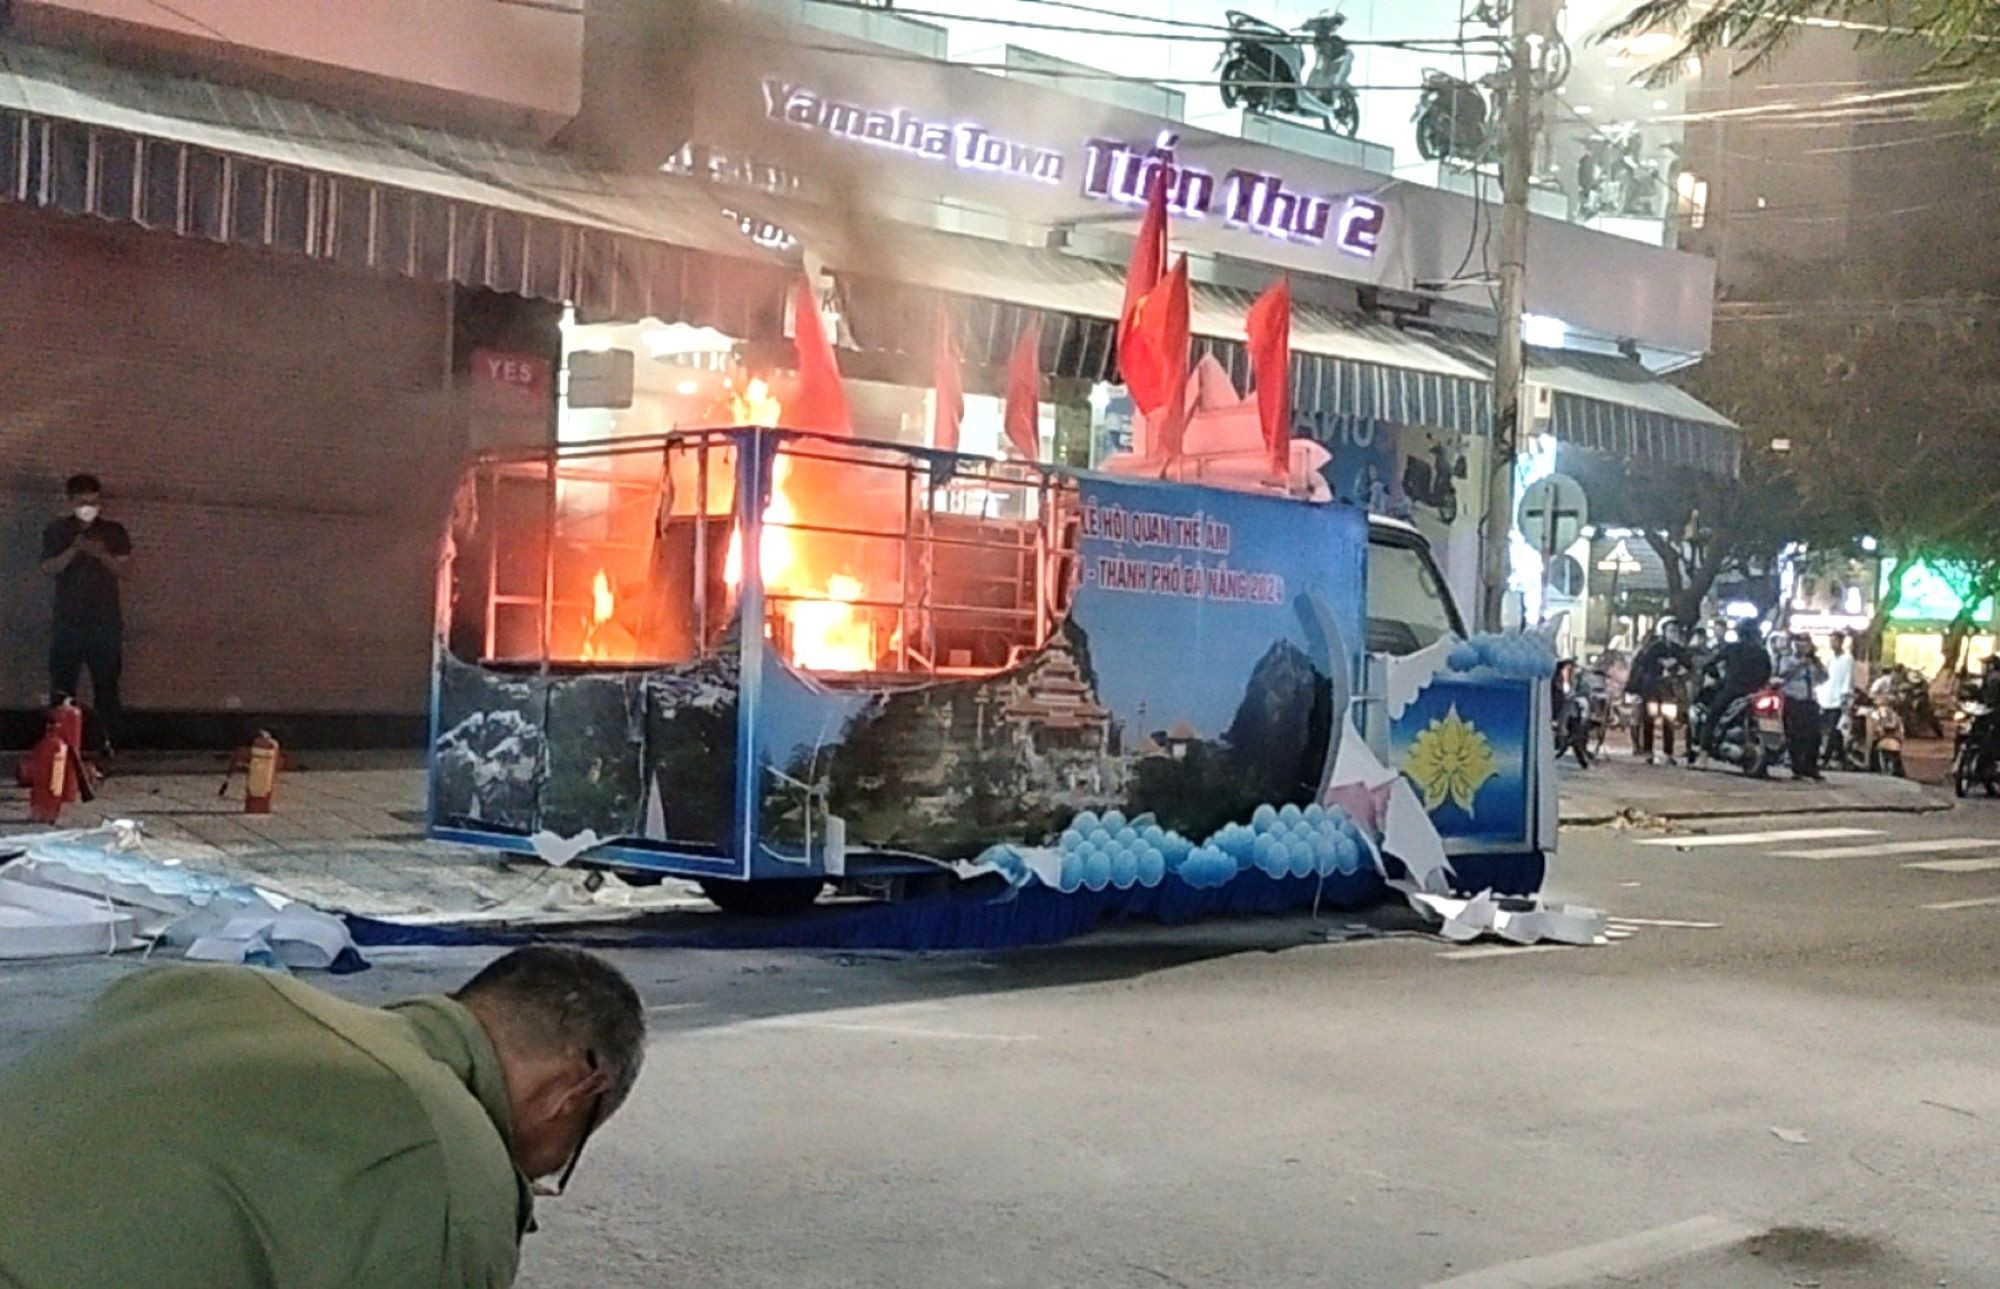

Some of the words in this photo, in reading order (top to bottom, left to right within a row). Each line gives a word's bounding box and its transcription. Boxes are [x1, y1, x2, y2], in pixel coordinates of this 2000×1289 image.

[761, 78, 951, 158] Yamaha
[955, 123, 1064, 184] Town
[1223, 167, 1332, 244] Thu
[1338, 196, 1386, 257] 2
[487, 358, 533, 384] YES
[1131, 511, 1172, 548] QUAN
